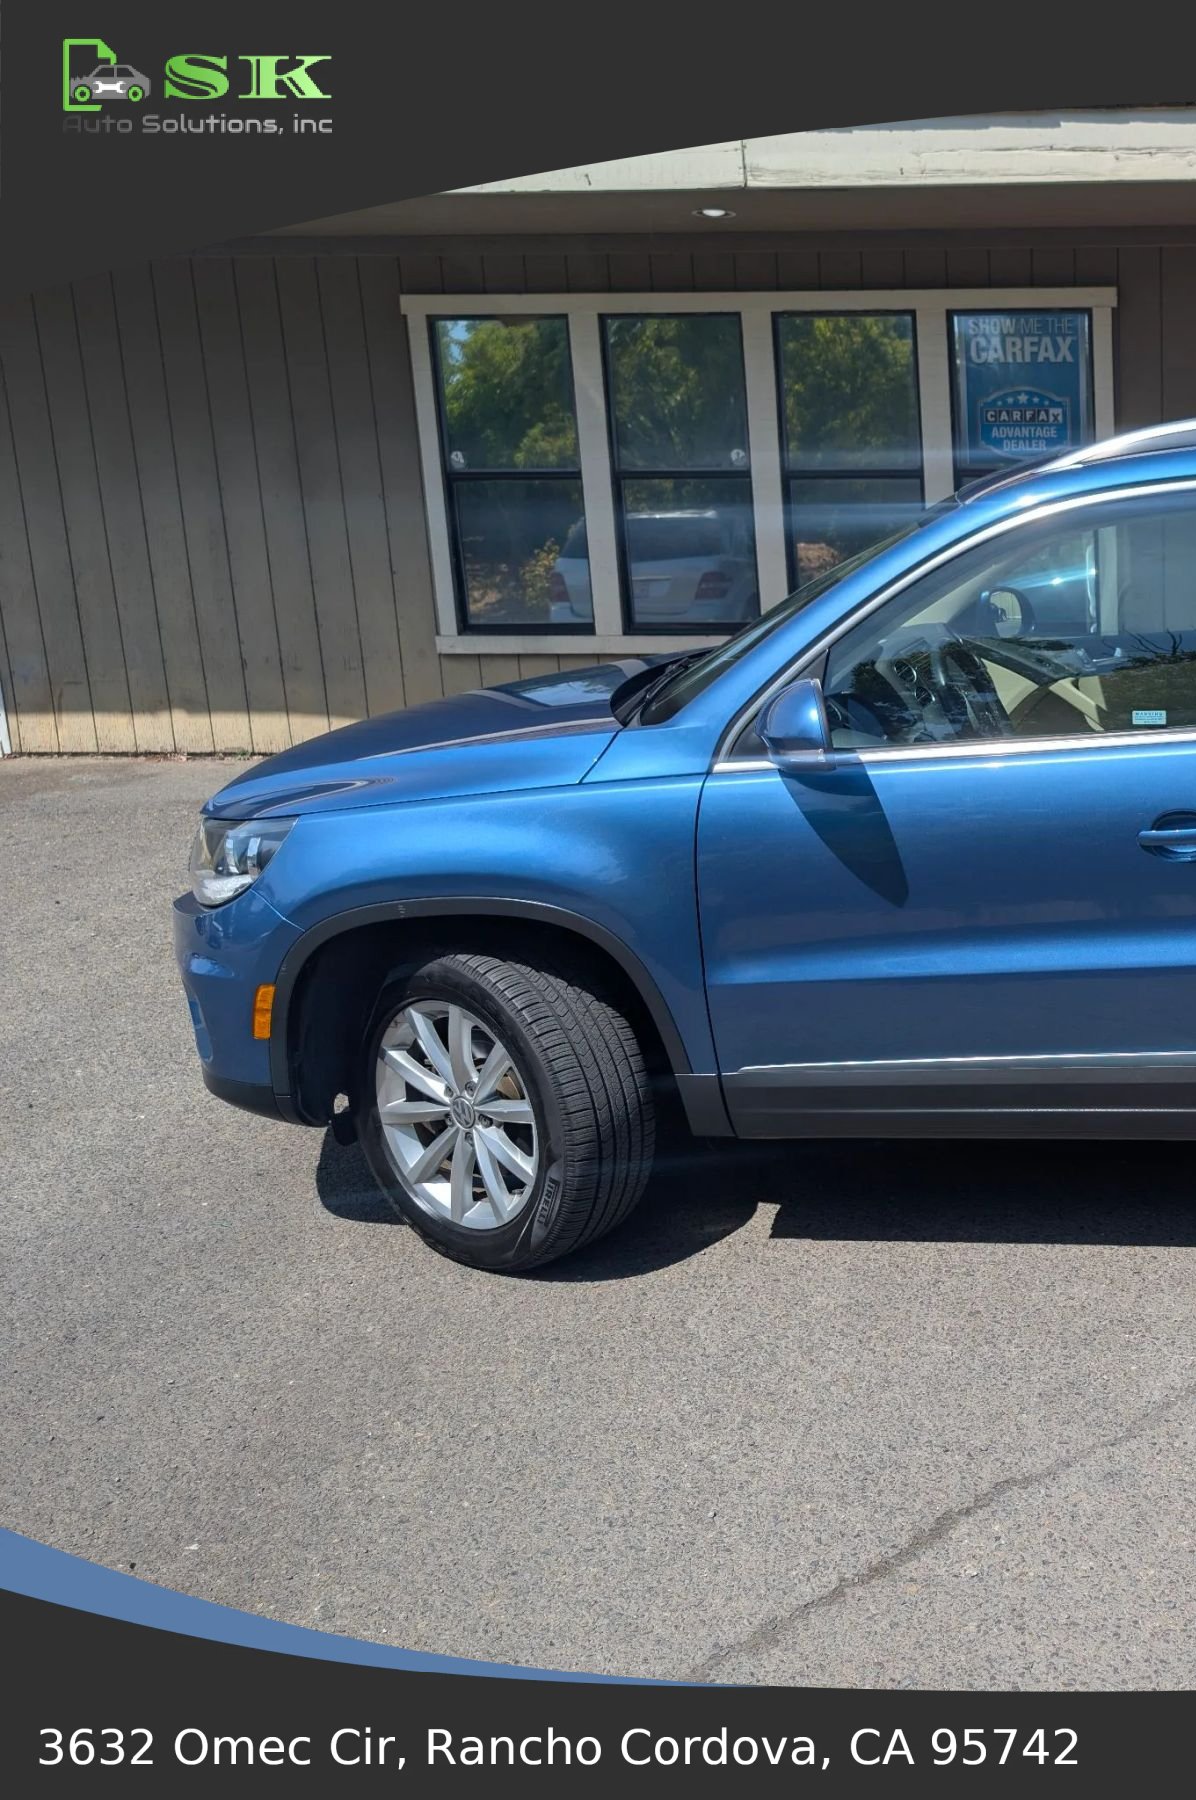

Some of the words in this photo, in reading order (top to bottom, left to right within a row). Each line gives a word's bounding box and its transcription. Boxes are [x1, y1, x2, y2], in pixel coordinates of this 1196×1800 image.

[968, 318, 1016, 335] SHOW
[1020, 318, 1044, 334] ME
[1048, 318, 1073, 333] THE
[970, 336, 1075, 363] CARFAX
[986, 408, 1062, 423] CARFAX
[991, 426, 1057, 438] ADVANTAGE
[1003, 439, 1047, 451] DEALER
